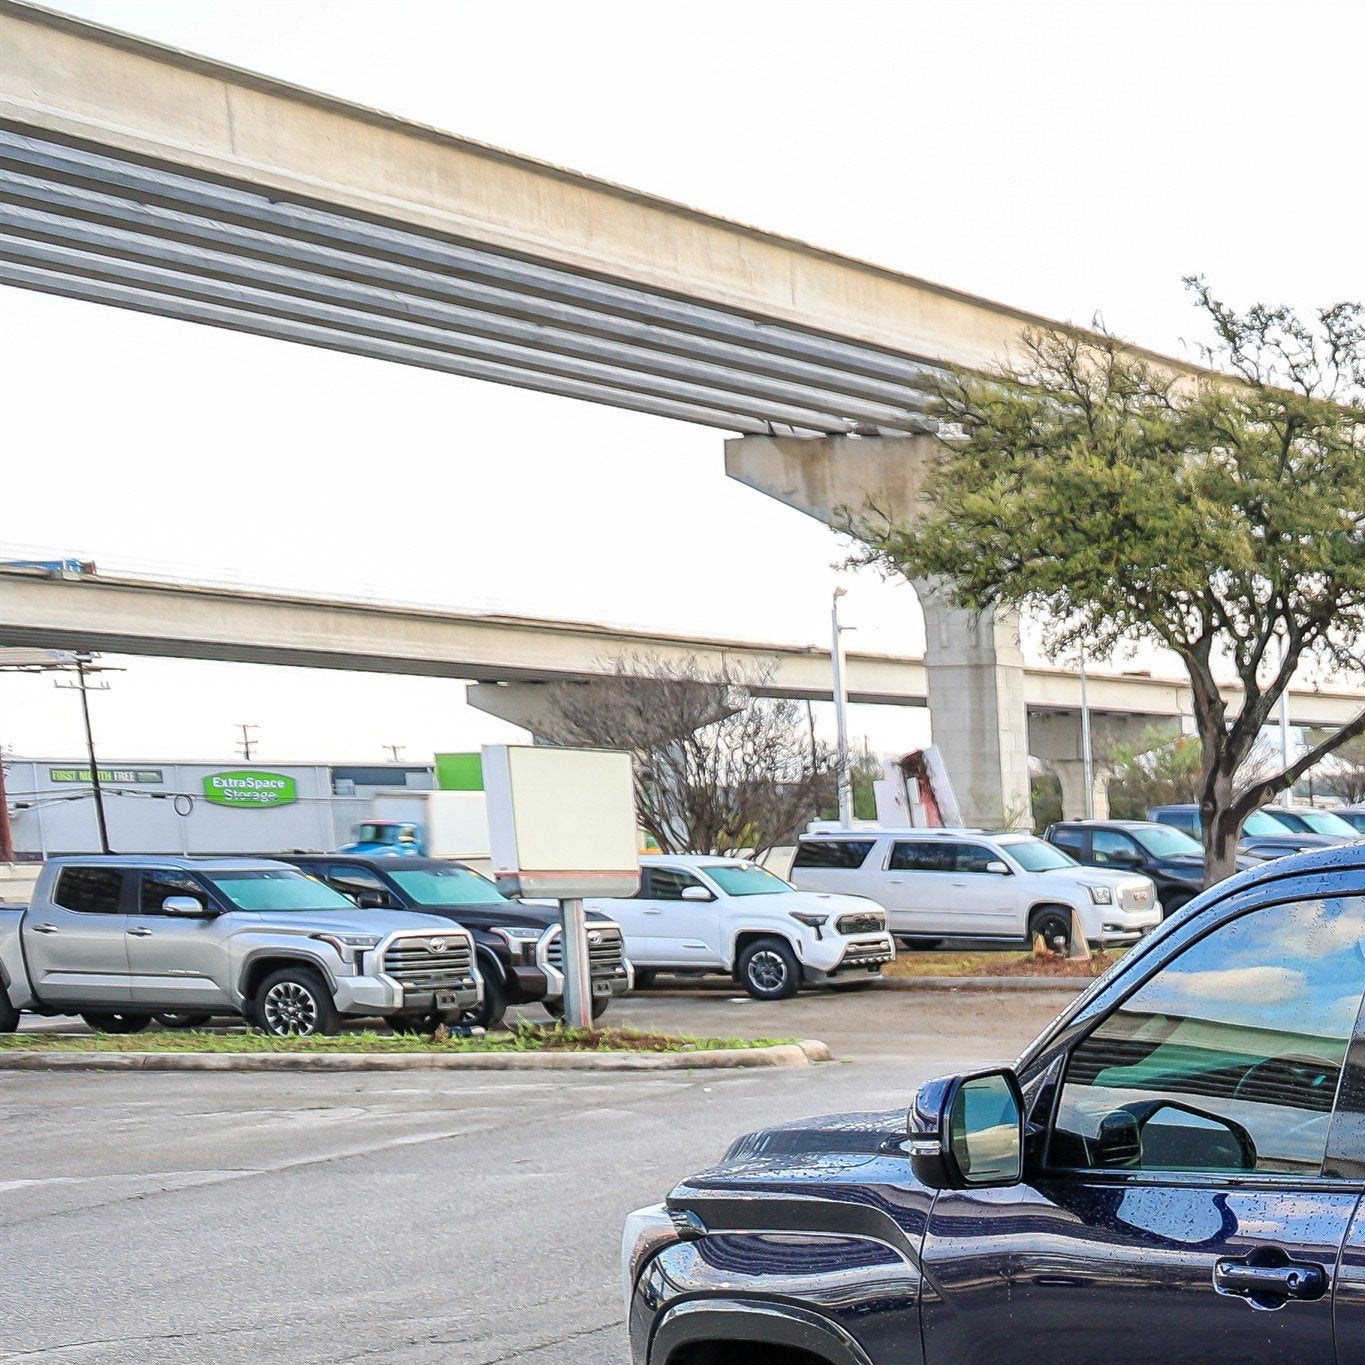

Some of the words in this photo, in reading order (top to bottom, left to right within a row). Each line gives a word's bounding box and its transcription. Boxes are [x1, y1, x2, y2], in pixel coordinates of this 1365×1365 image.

[52, 771, 77, 780] FIRST
[114, 772, 135, 780] FREE
[223, 789, 278, 802] Storage
